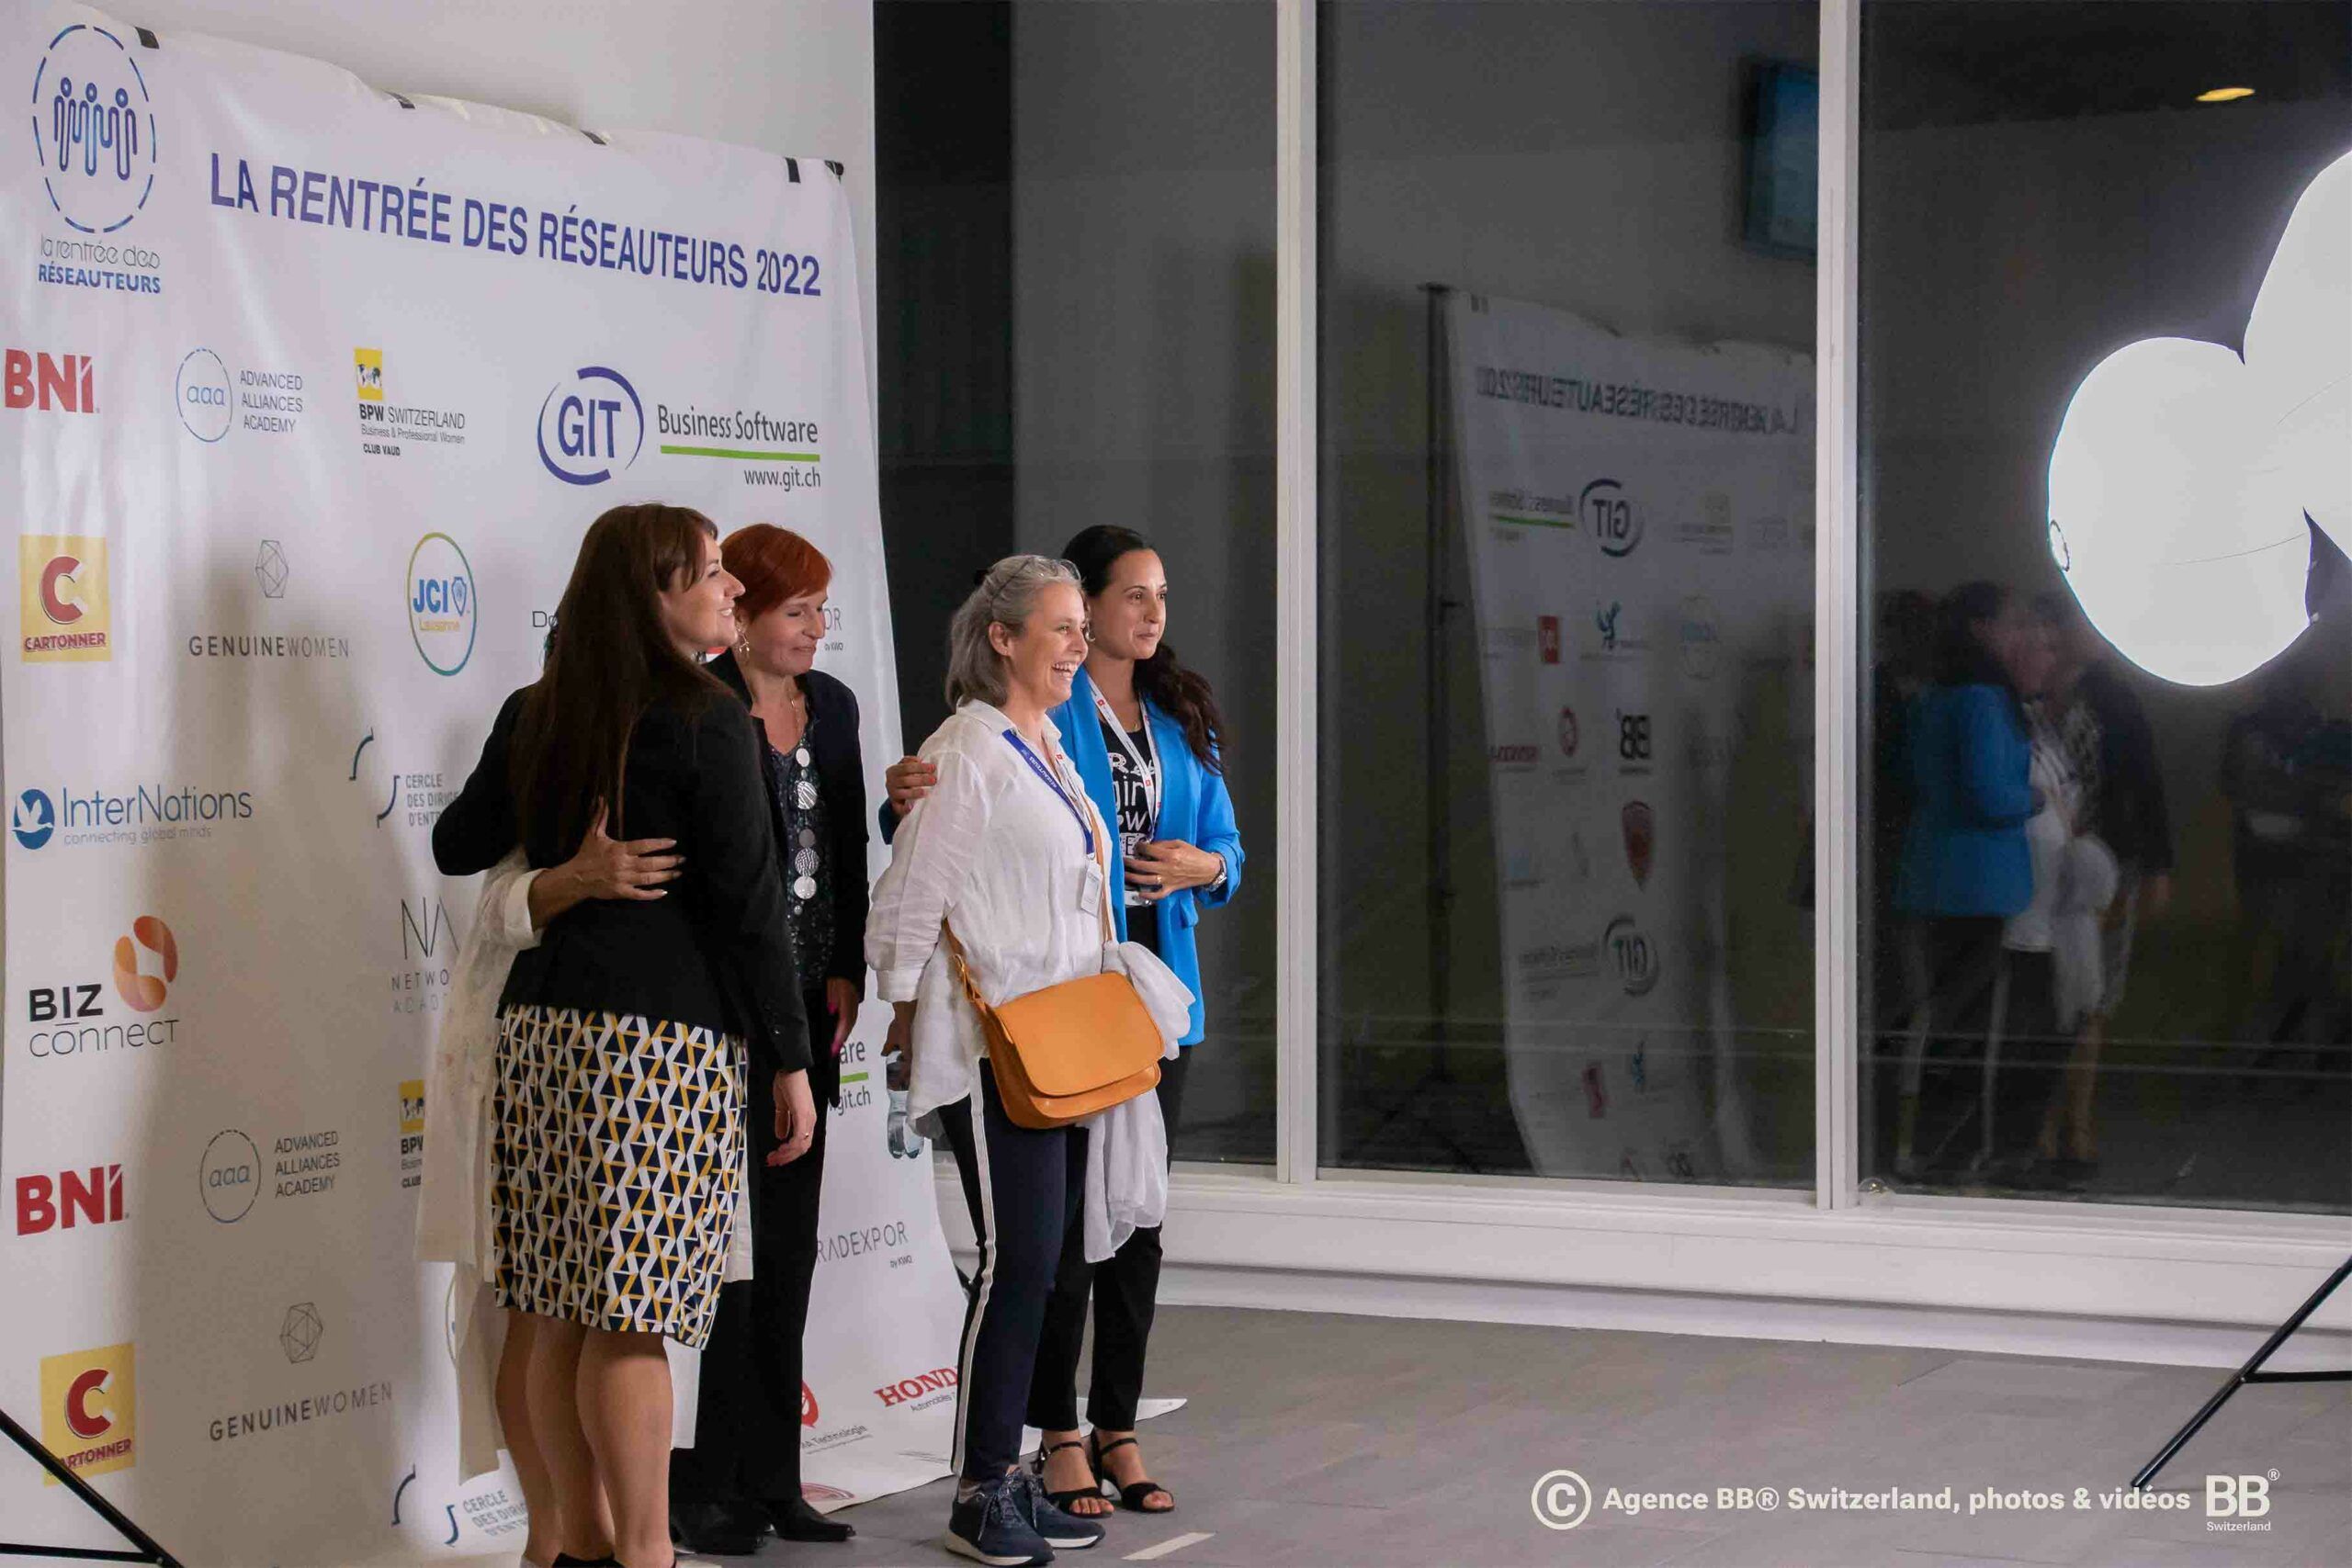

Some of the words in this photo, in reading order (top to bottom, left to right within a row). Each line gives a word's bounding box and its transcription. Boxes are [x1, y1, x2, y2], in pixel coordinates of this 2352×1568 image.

[210, 152, 259, 213] LA
[271, 165, 451, 243] RENTRÉE
[463, 198, 528, 255] DES
[538, 205, 748, 288] RÉSEAUTEURS
[756, 249, 821, 297] 2022
[38, 264, 161, 294] RÉSEAUTEURS
[5, 348, 94, 413] BNI
[240, 370, 303, 389] ADVANCED
[187, 385, 225, 406] aaa
[242, 393, 303, 412] ALLIANCES
[243, 414, 296, 433] ACADEMY
[359, 403, 384, 422] BPW
[388, 407, 466, 429] SWITZERLAND
[558, 395, 622, 458] GIT
[658, 404, 731, 439] Business
[735, 411, 818, 443] Software
[363, 444, 381, 455] CLUB
[382, 446, 401, 457] VAUD
[744, 467, 820, 491] www.git.ch
[413, 579, 448, 614] JCI
[24, 632, 107, 652] CARTONNER
[188, 635, 349, 659] GENUINEWOMEN
[405, 773, 443, 788] CERCLE
[62, 784, 252, 827] InterNations
[407, 793, 424, 808] DES
[64, 831, 137, 846] connecting
[141, 827, 177, 841] global
[179, 826, 212, 839] minds
[29, 984, 103, 1021] BIZ
[275, 1131, 339, 1154] ADVANCED
[275, 1153, 340, 1177] ALLIANCES
[275, 1175, 335, 1199] ACADEMY
[16, 1164, 123, 1236] BNI
[209, 1382, 392, 1442] GENUINEWOMEN
[463, 1490, 508, 1513] CERCLE
